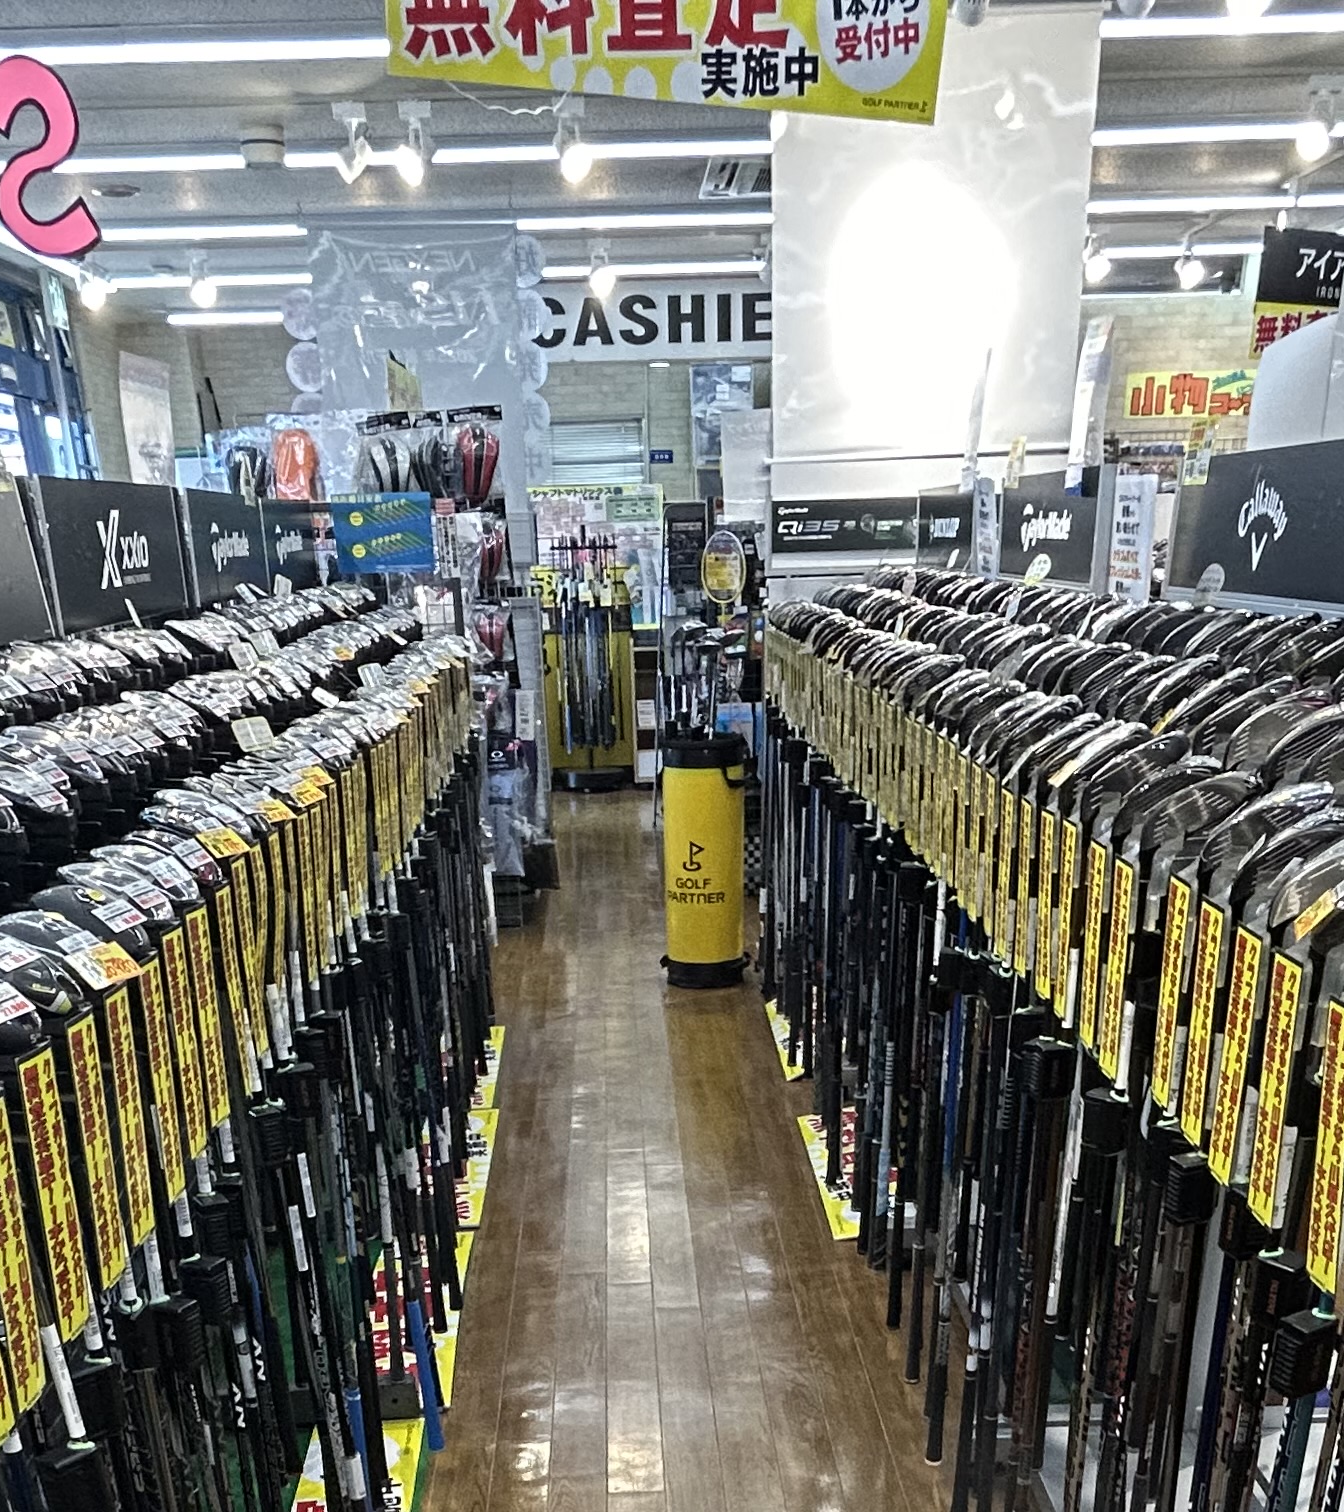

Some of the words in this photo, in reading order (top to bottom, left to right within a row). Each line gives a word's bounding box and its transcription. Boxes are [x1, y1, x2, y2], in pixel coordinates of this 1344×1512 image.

[834, 22, 921, 64] 受付中
[700, 48, 820, 98] 実施中
[1237, 481, 1288, 543] Callaway
[668, 891, 726, 904] PARTNER
[675, 877, 712, 890] GOLF
